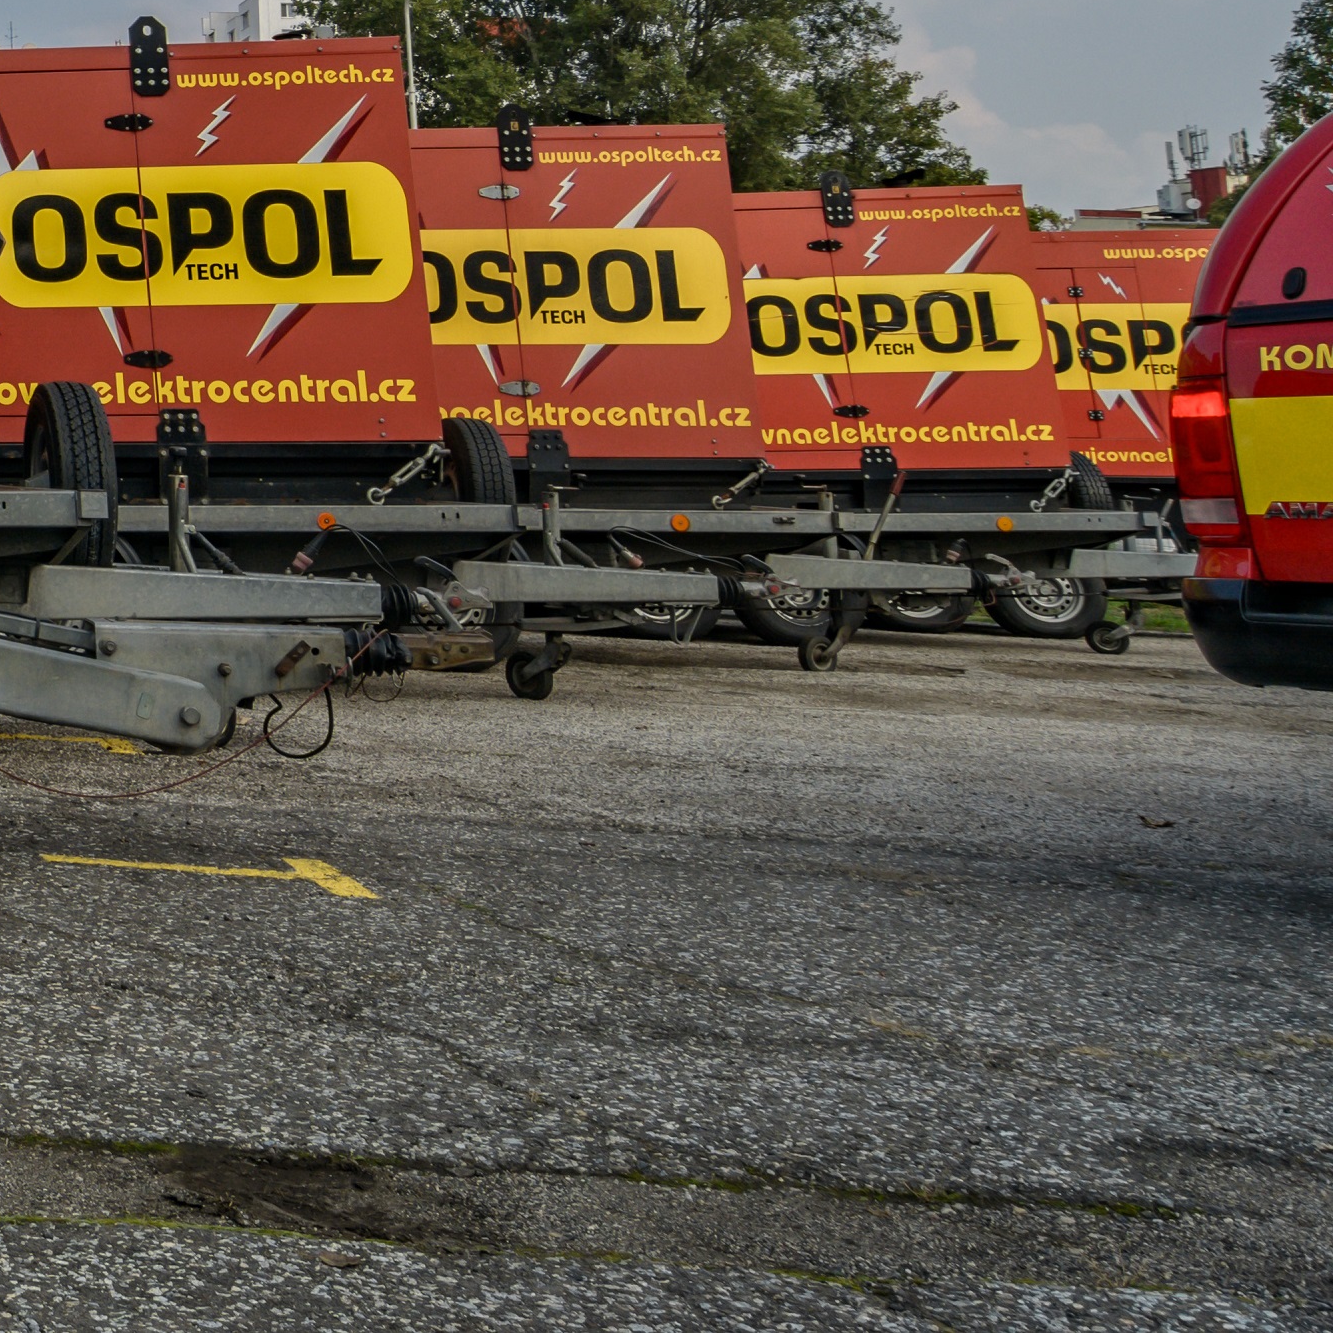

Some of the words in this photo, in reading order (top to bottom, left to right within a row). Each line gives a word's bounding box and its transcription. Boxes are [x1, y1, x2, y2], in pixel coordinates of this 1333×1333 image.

[176, 63, 395, 91] www.ospoltech.cz
[537, 145, 722, 167] www.ospoltech.cz
[857, 202, 1022, 222] www.ospoltech.cz
[11, 189, 384, 282] OSPOL
[185, 263, 239, 281] TECH
[541, 310, 586, 324] TECH
[745, 291, 1020, 357] OSPOL
[874, 343, 914, 356] TECH
[761, 418, 1055, 445] vnaelektrocentral.cz
